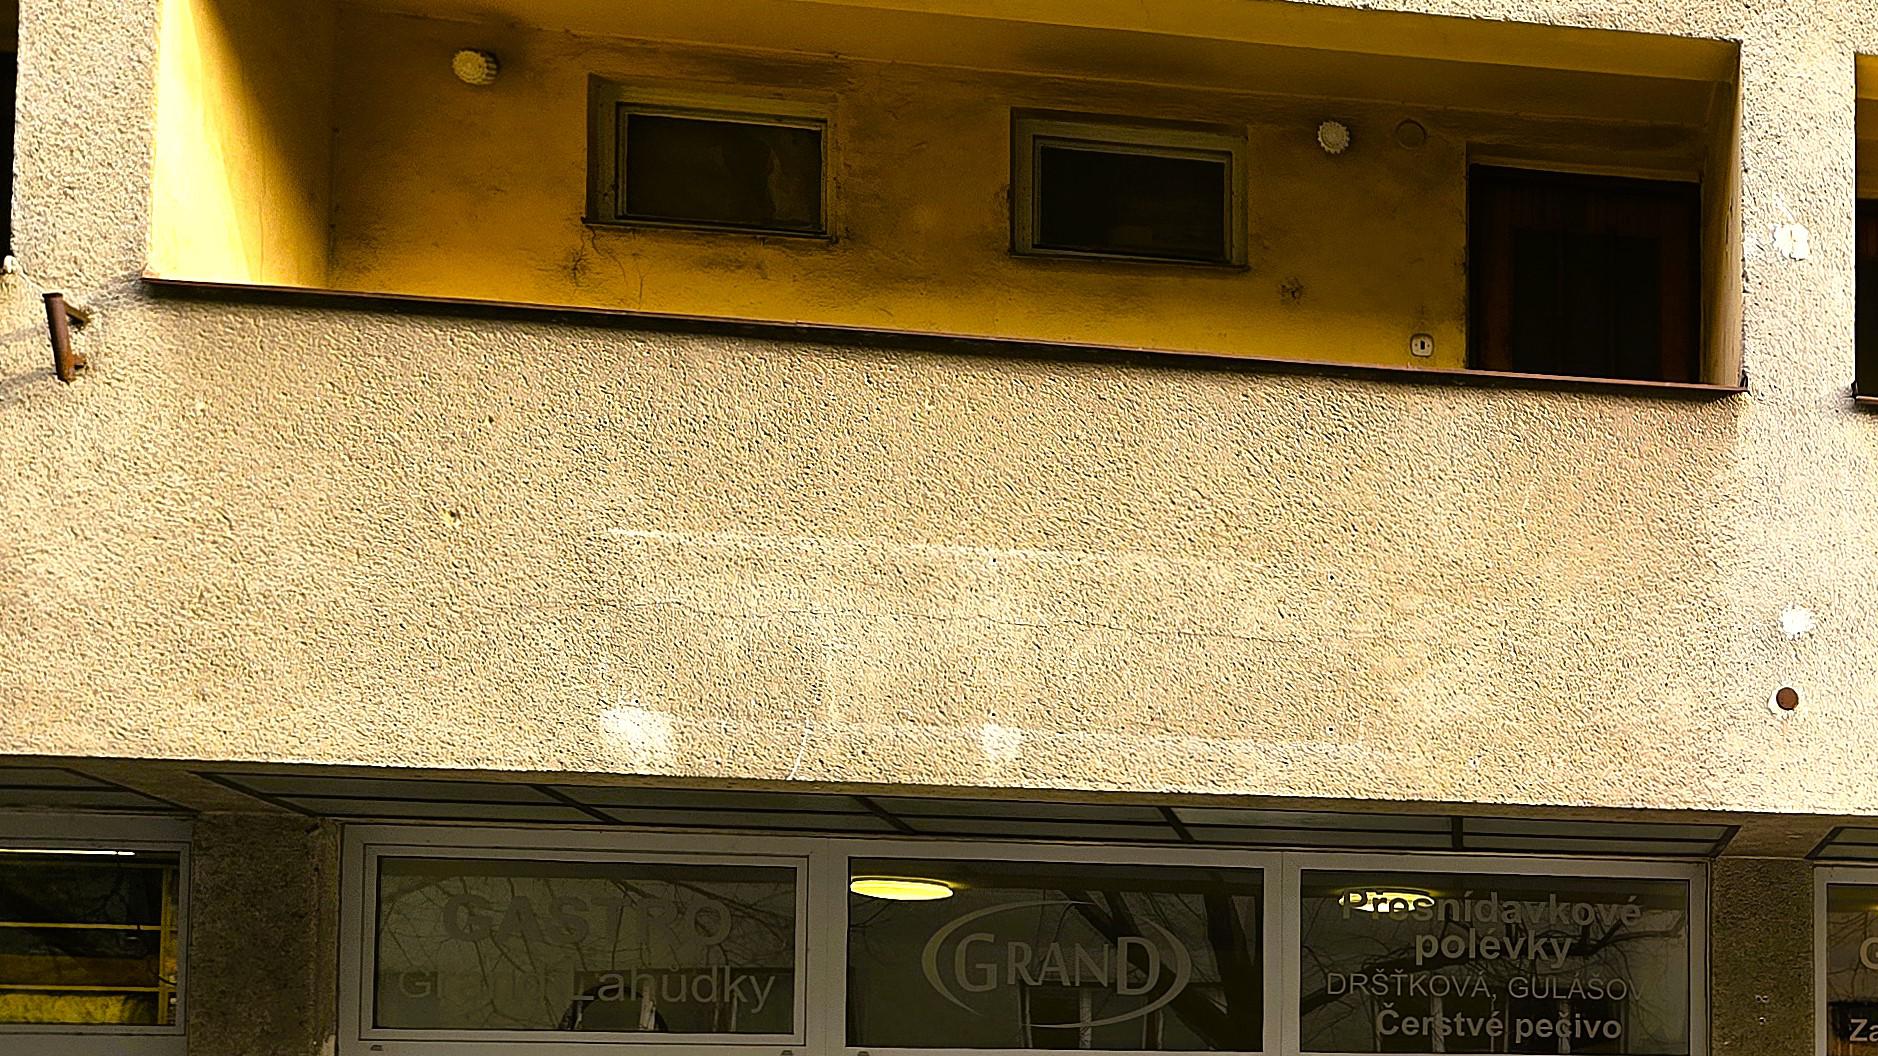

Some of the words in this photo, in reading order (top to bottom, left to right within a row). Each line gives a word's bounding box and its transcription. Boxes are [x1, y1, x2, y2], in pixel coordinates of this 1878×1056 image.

[442, 893, 734, 945] GASTRO
[953, 931, 1161, 996] GRAND
[1415, 927, 1574, 967] polévky
[1326, 968, 1498, 1002] DRŠŤKOVÁ,
[1508, 971, 1649, 1002] GULÁŠOV
[1376, 1002, 1504, 1037] Čerstvé
[1515, 1011, 1622, 1044] pečivo
